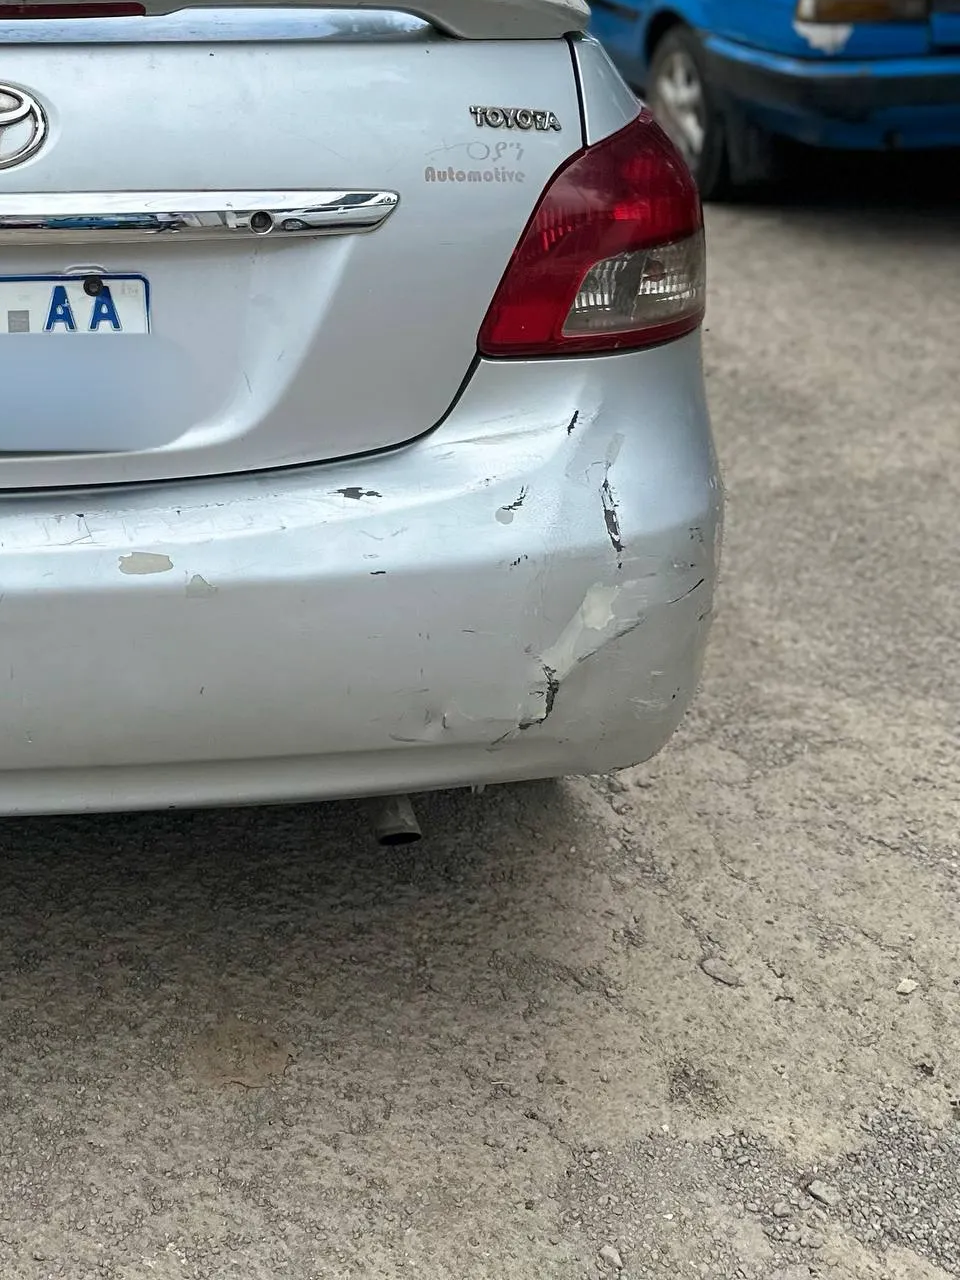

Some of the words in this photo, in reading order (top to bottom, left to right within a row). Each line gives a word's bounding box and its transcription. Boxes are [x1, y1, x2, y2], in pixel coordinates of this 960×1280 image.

[469, 105, 562, 132] TOYOTA
[424, 166, 526, 183] Automotive
[44, 284, 122, 332] AA
